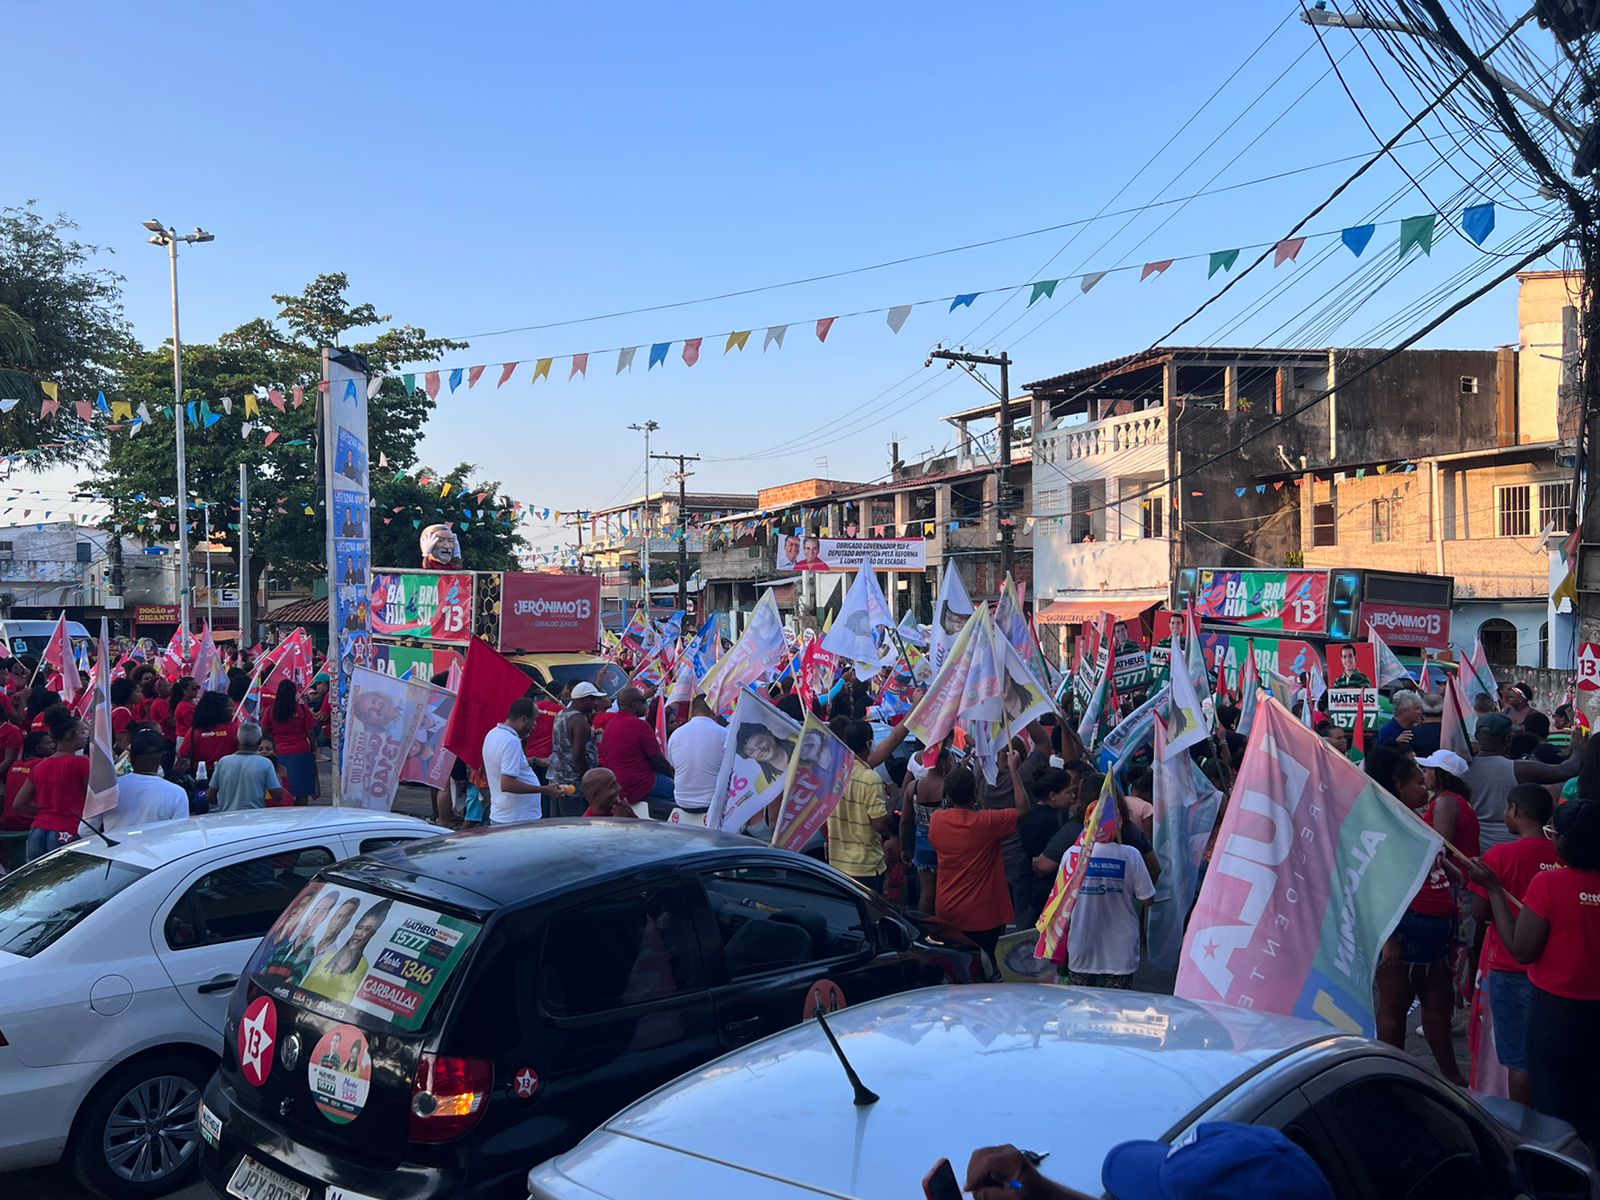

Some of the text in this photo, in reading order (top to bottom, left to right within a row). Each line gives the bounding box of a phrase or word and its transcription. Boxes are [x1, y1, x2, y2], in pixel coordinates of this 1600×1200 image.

[863, 542, 896, 550] GOVERNADOR
[844, 557, 876, 565] CONSTRÃO
[386, 584, 405, 604] BA
[418, 585, 439, 605] BRA
[1227, 581, 1248, 599] BA
[1263, 582, 1287, 600] BRA
[139, 606, 166, 614] DOGÃO
[386, 604, 406, 625] HIA
[417, 606, 432, 625] SIL
[1224, 599, 1247, 617] HIA
[1261, 600, 1279, 617] SIL
[1292, 600, 1317, 624] 13
[442, 605, 464, 632] 13
[1115, 655, 1145, 669] ATHEUS
[1580, 658, 1596, 677] 13
[1116, 670, 1146, 688] 5777
[1330, 712, 1377, 728] 1577
[402, 919, 438, 937] MATHEUS
[393, 930, 429, 950] 15777
[401, 960, 434, 984] 1346
[363, 978, 417, 1011] CARBALLAL
[250, 1026, 261, 1059] 13
[522, 1077, 530, 1088] 13
[269, 1170, 299, 1192] SALVADOR
